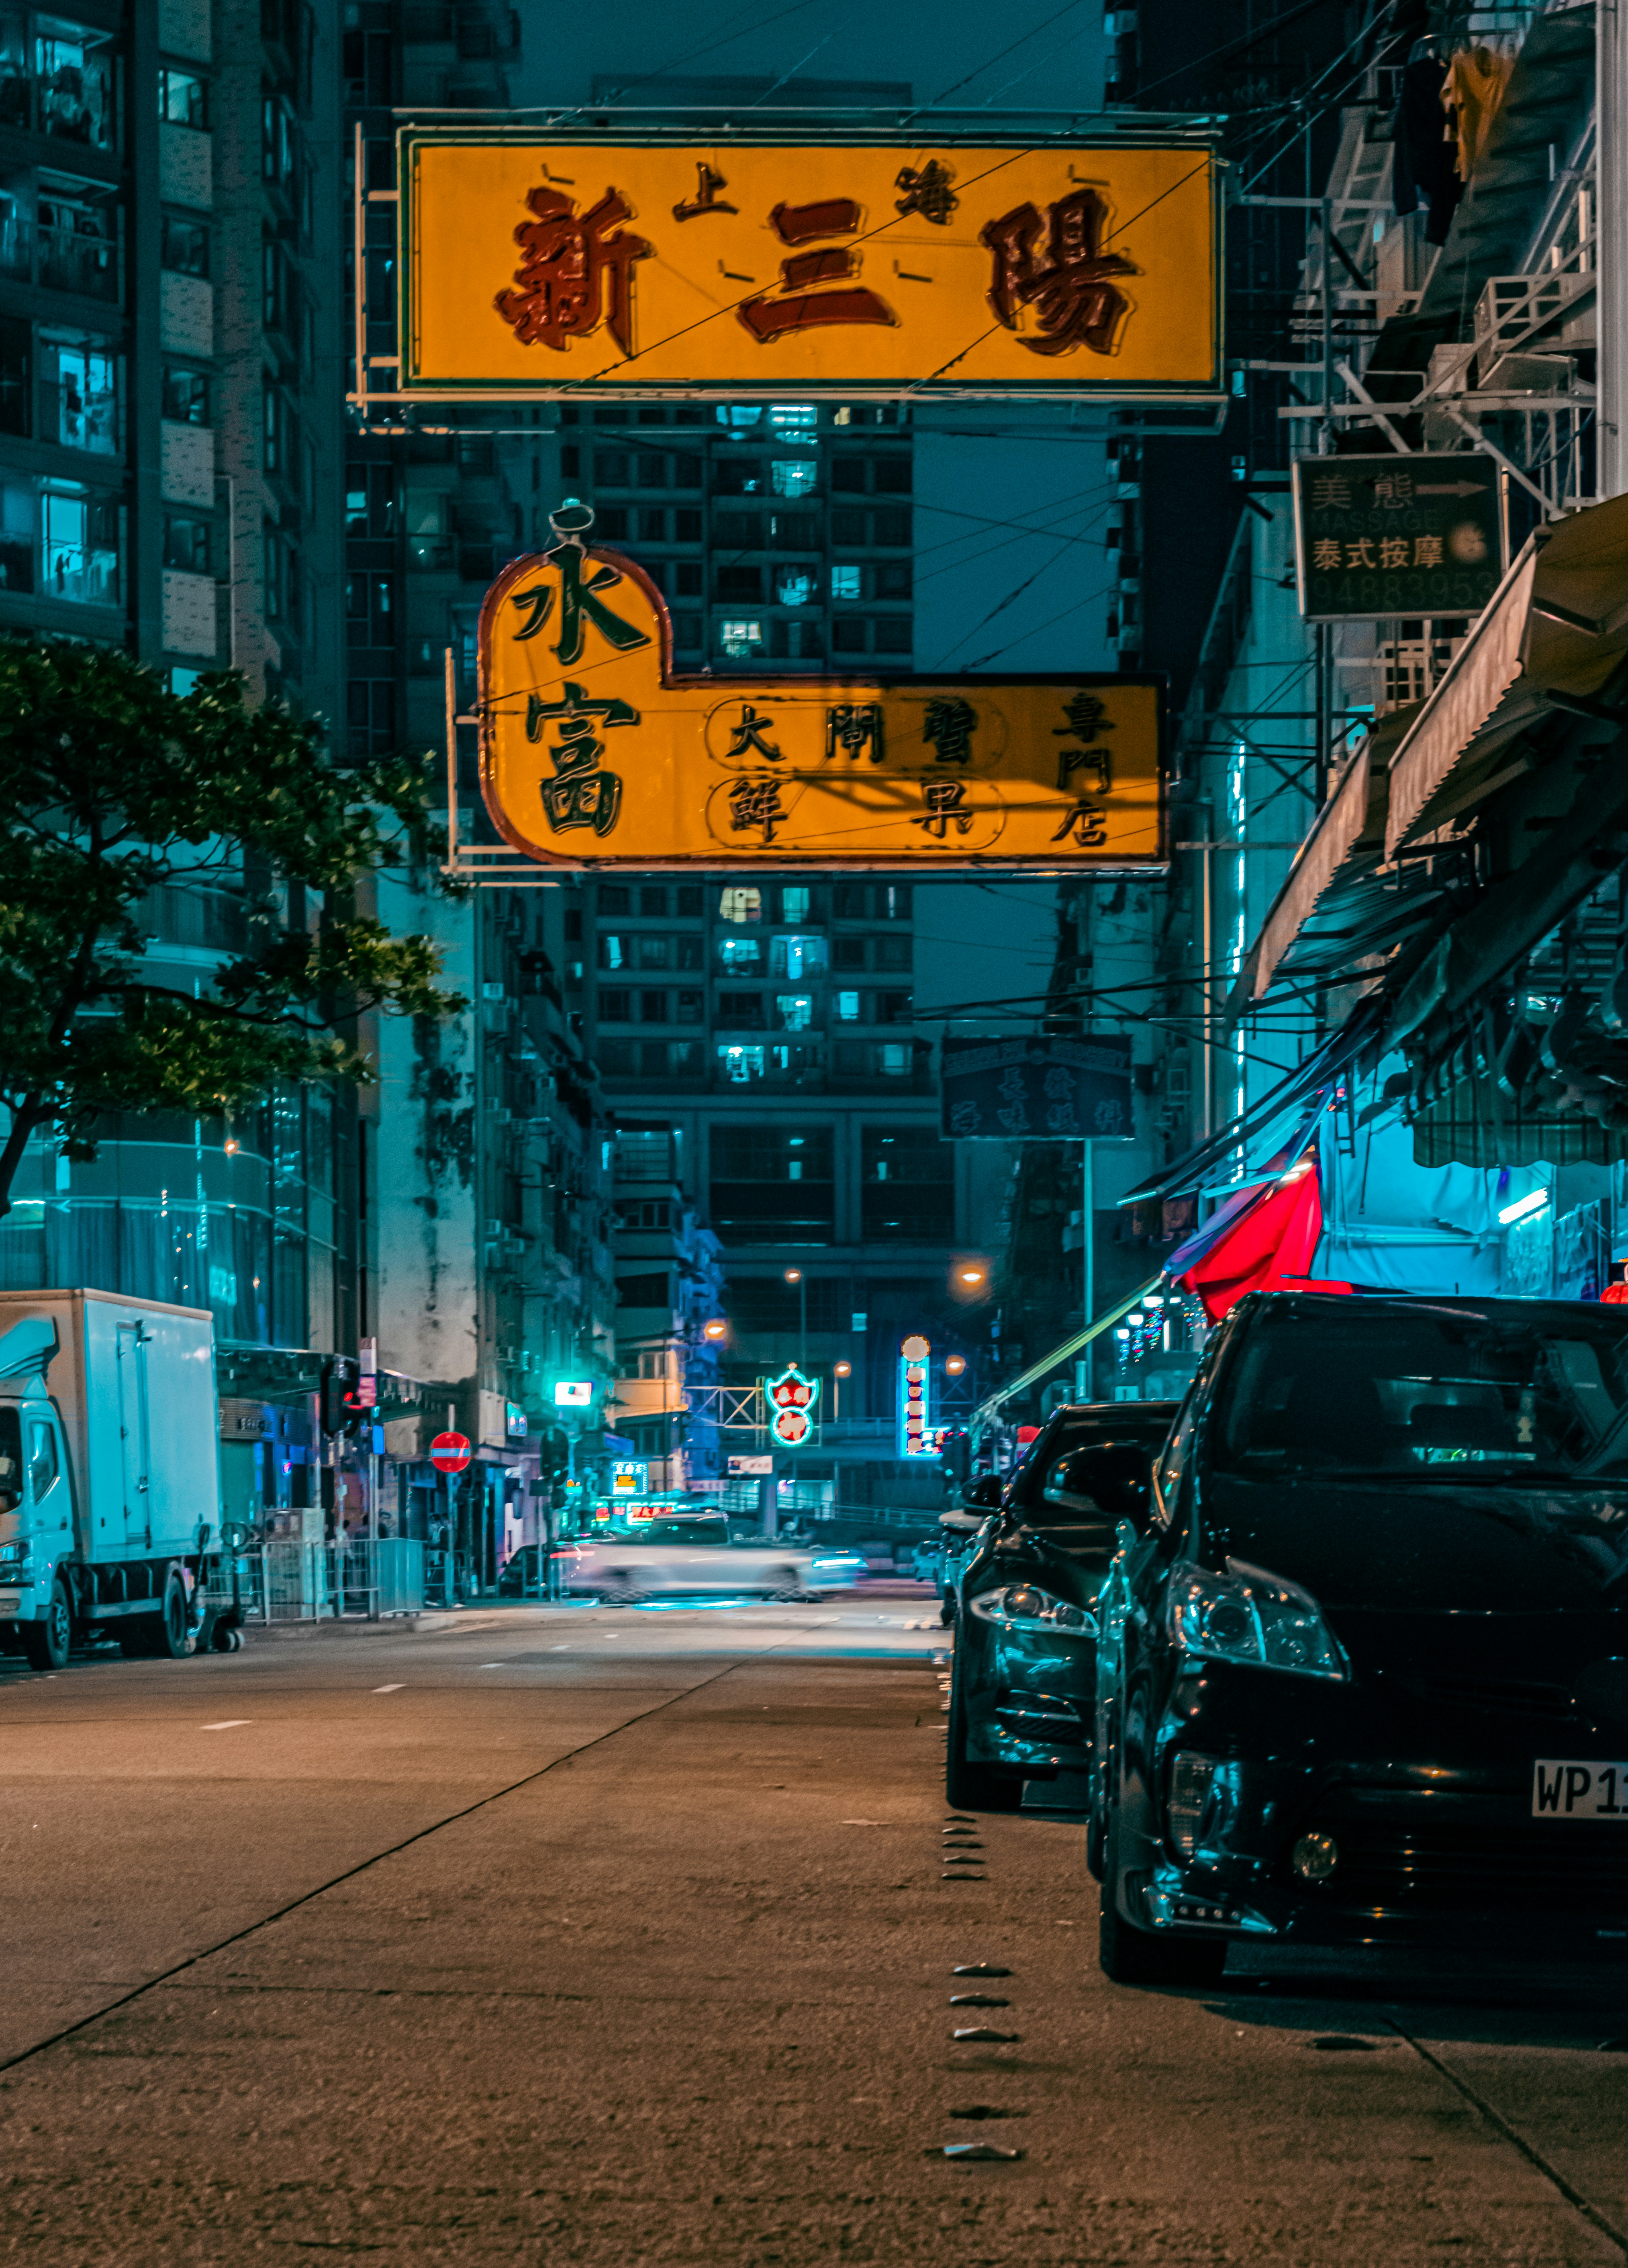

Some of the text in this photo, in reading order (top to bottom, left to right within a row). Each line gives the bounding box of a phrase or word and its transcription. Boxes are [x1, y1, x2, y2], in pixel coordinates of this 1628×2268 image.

[492, 186, 1146, 358] 新三陽
[1310, 472, 1414, 509] 美態
[1310, 510, 1440, 533] MASSAGE
[1312, 535, 1445, 571] 泰式按摩
[725, 700, 979, 765] 大閘蟹
[728, 780, 975, 843] 鮮果
[1049, 1039, 1129, 1068] GROCERY
[1537, 1765, 1628, 1813] WP1
